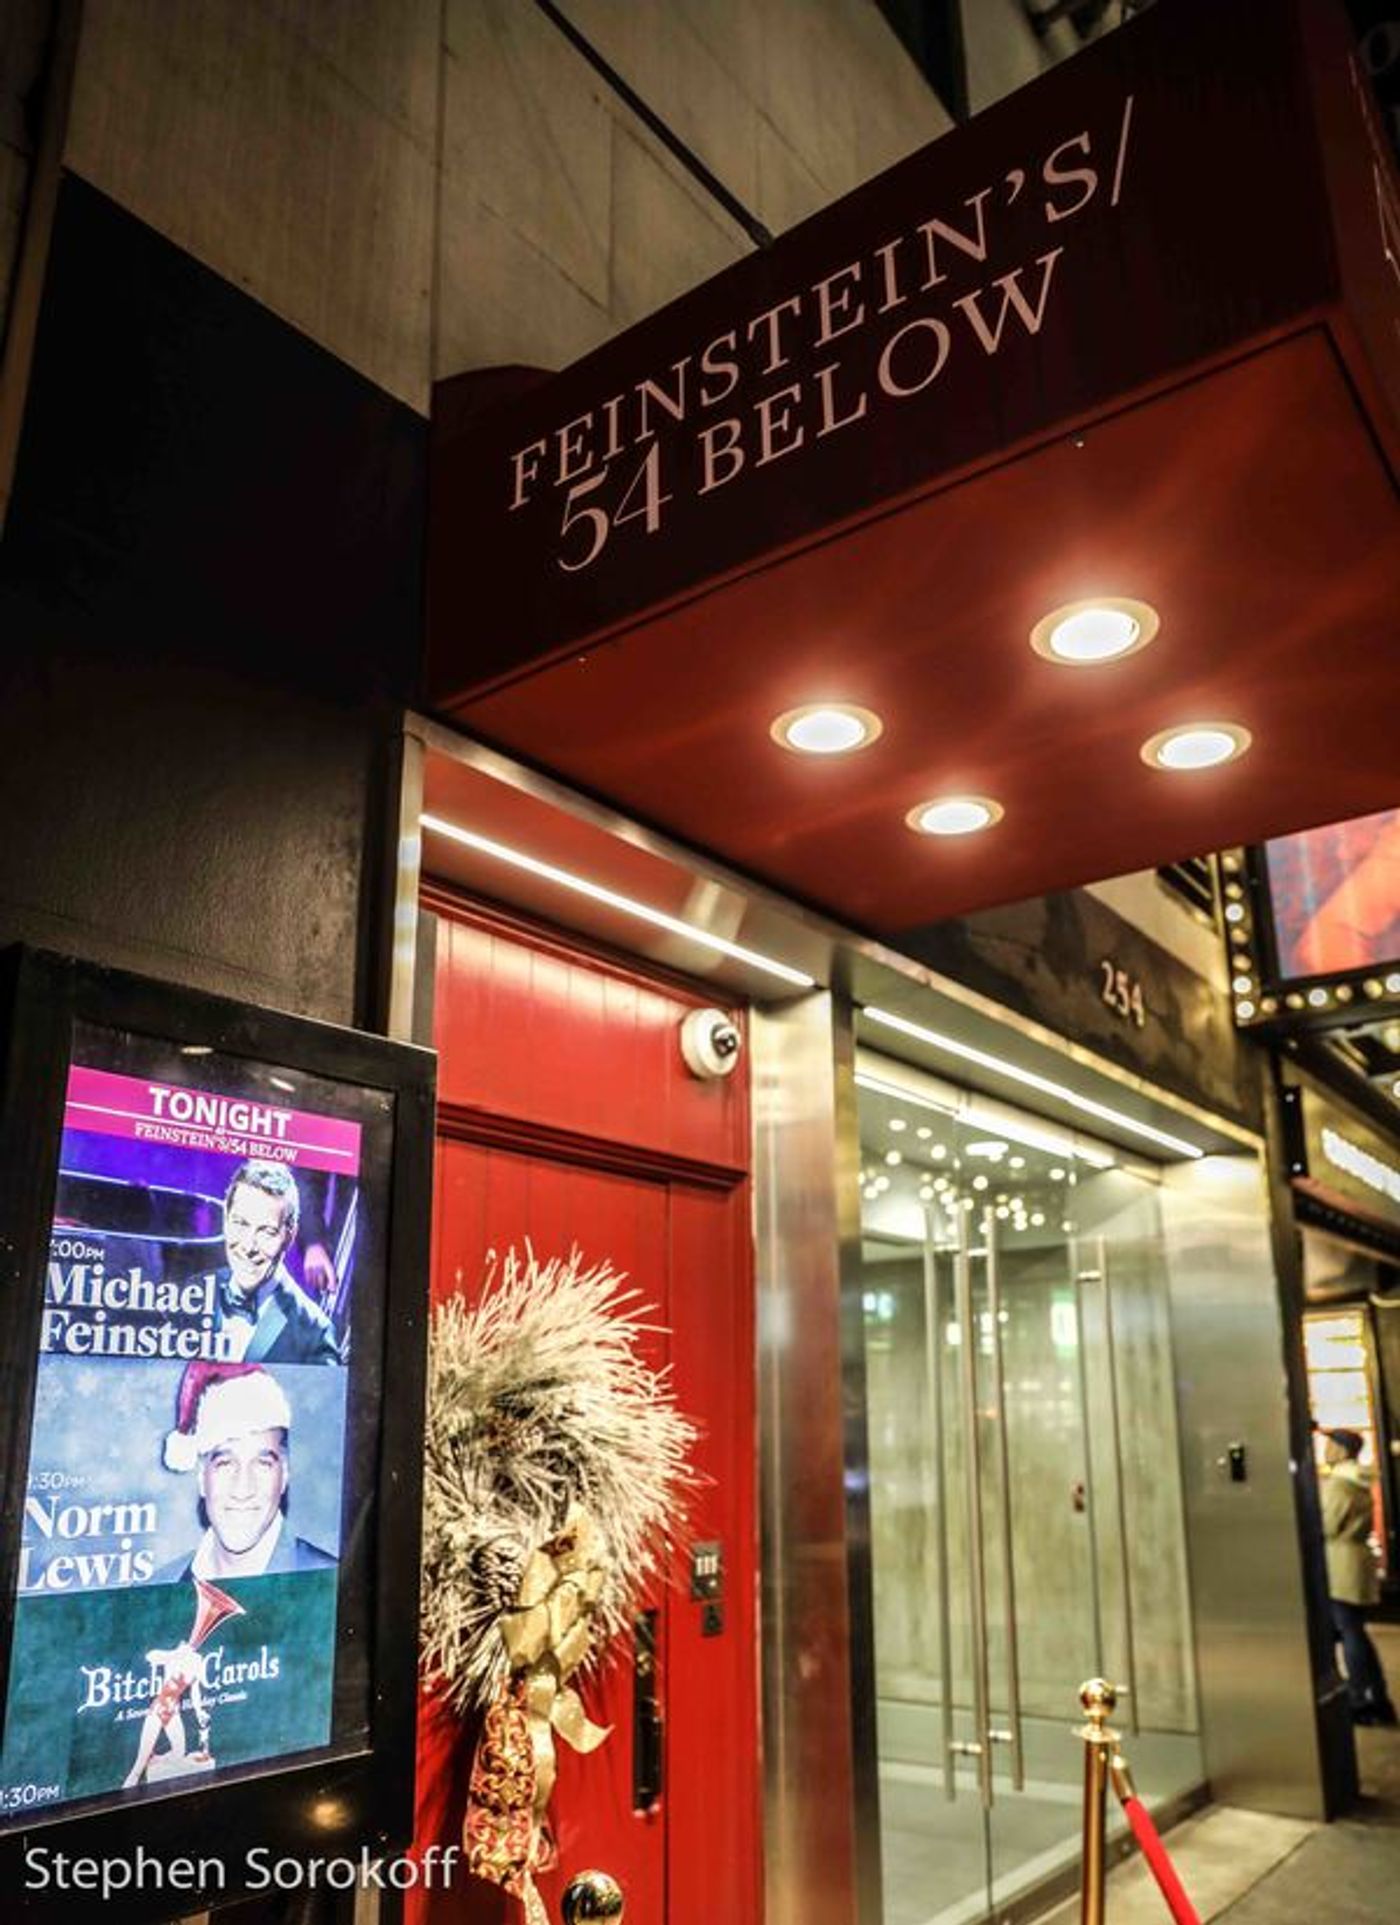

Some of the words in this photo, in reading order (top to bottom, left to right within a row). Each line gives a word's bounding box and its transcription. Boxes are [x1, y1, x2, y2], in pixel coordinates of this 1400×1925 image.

[556, 440, 673, 571] 54
[697, 246, 1064, 496] BELOW
[1101, 960, 1144, 1027] 254
[149, 1087, 291, 1138] TONIGHT
[249, 1142, 298, 1162] BELOW
[44, 1262, 216, 1315] Michael
[39, 1309, 243, 1362] Feinstein
[22, 1495, 157, 1539] Norm
[18, 1537, 154, 1590] Lewis
[200, 1645, 280, 1689] Carols
